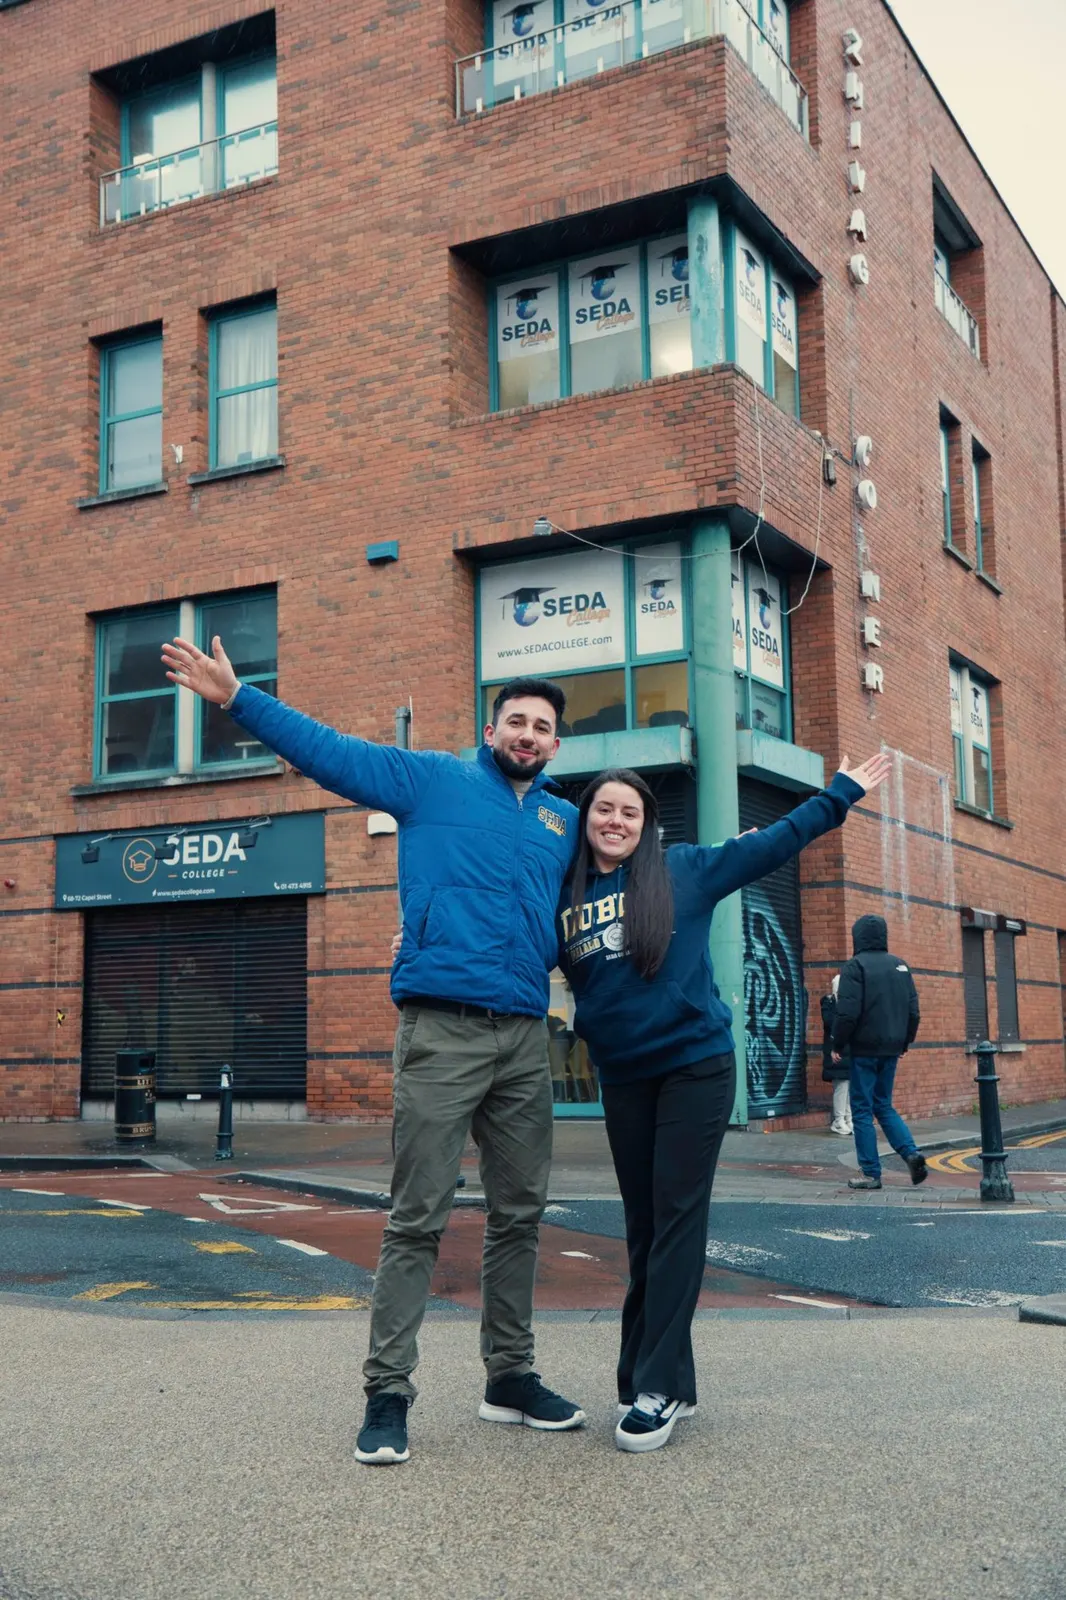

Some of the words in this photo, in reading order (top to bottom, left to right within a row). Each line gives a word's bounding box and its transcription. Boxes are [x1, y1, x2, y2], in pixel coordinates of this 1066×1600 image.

[655, 283, 690, 306] SE
[739, 280, 762, 316] SEDA
[575, 298, 632, 324] SEDA
[502, 318, 552, 341] SEDA
[771, 312, 793, 344] SEDA
[855, 435, 884, 694] CONER
[543, 592, 607, 617] SEDA
[566, 607, 611, 627] College
[641, 600, 675, 613] SEDA
[497, 636, 613, 658] www.SEDACOLLEGE.com
[752, 627, 779, 656] SEDA
[538, 805, 567, 834] SEDA
[163, 832, 246, 866] SEDA
[182, 868, 225, 879] COLLEGE
[82, 893, 96, 902] Capel
[96, 893, 112, 901] Street
[157, 887, 216, 896] www.sedacollege.com
[561, 892, 626, 943] DUB
